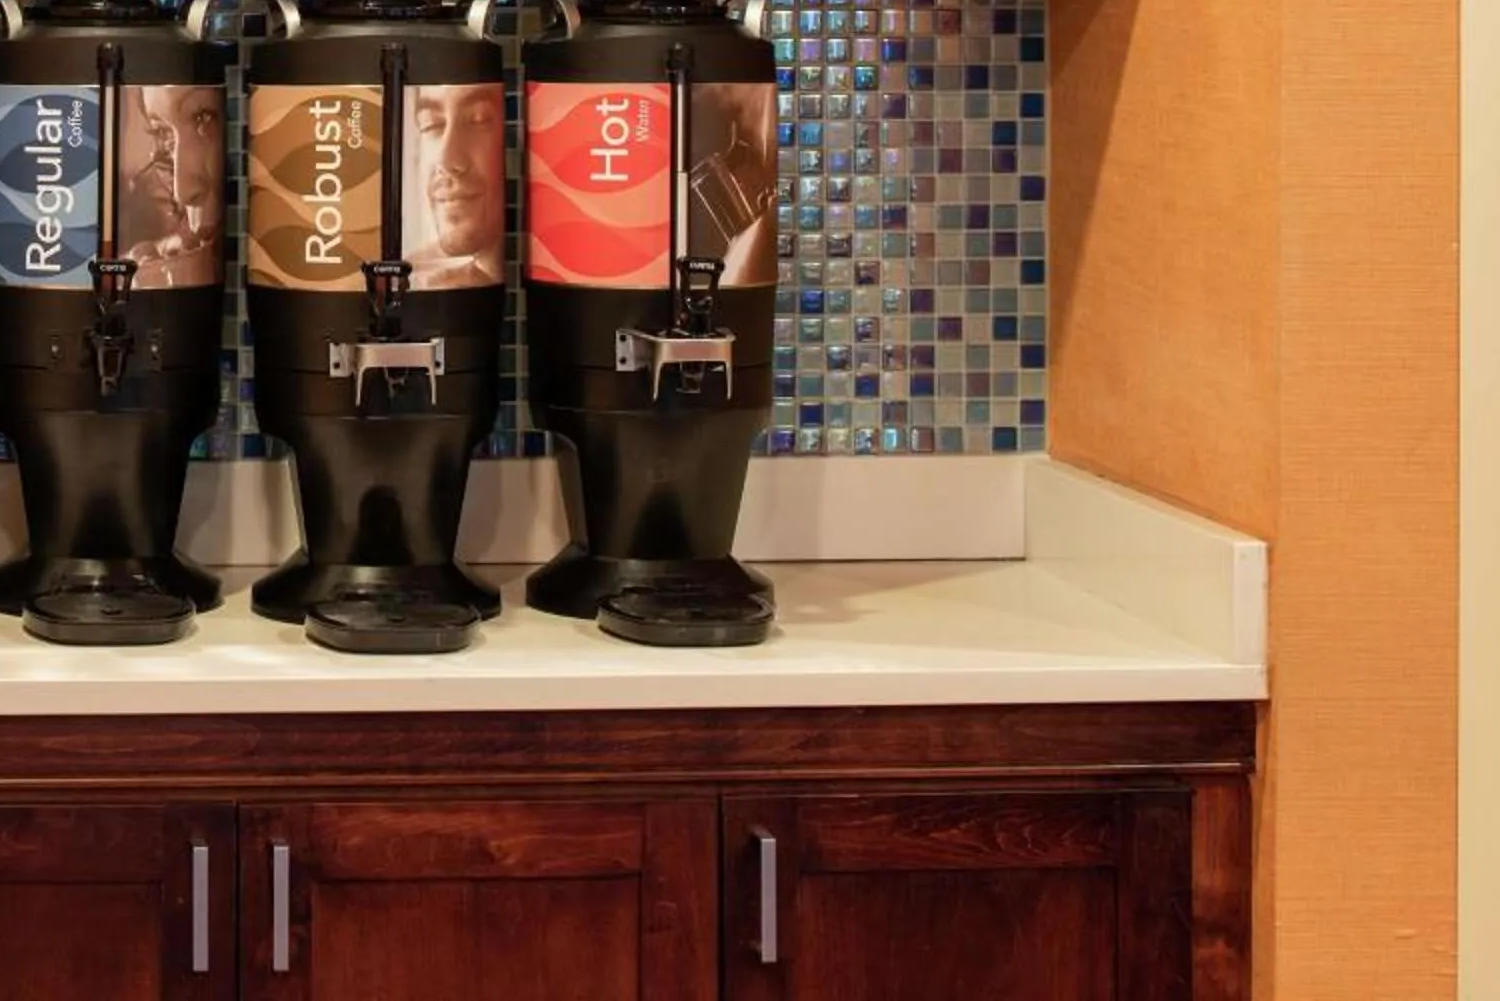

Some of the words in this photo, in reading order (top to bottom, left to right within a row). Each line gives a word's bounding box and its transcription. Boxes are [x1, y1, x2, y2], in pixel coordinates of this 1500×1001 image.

[68, 100, 83, 148] Coffee
[347, 100, 362, 149] Coffee
[590, 98, 630, 182] Hot
[634, 99, 650, 142] Water
[24, 99, 74, 271] Regular
[301, 100, 343, 264] Robust
